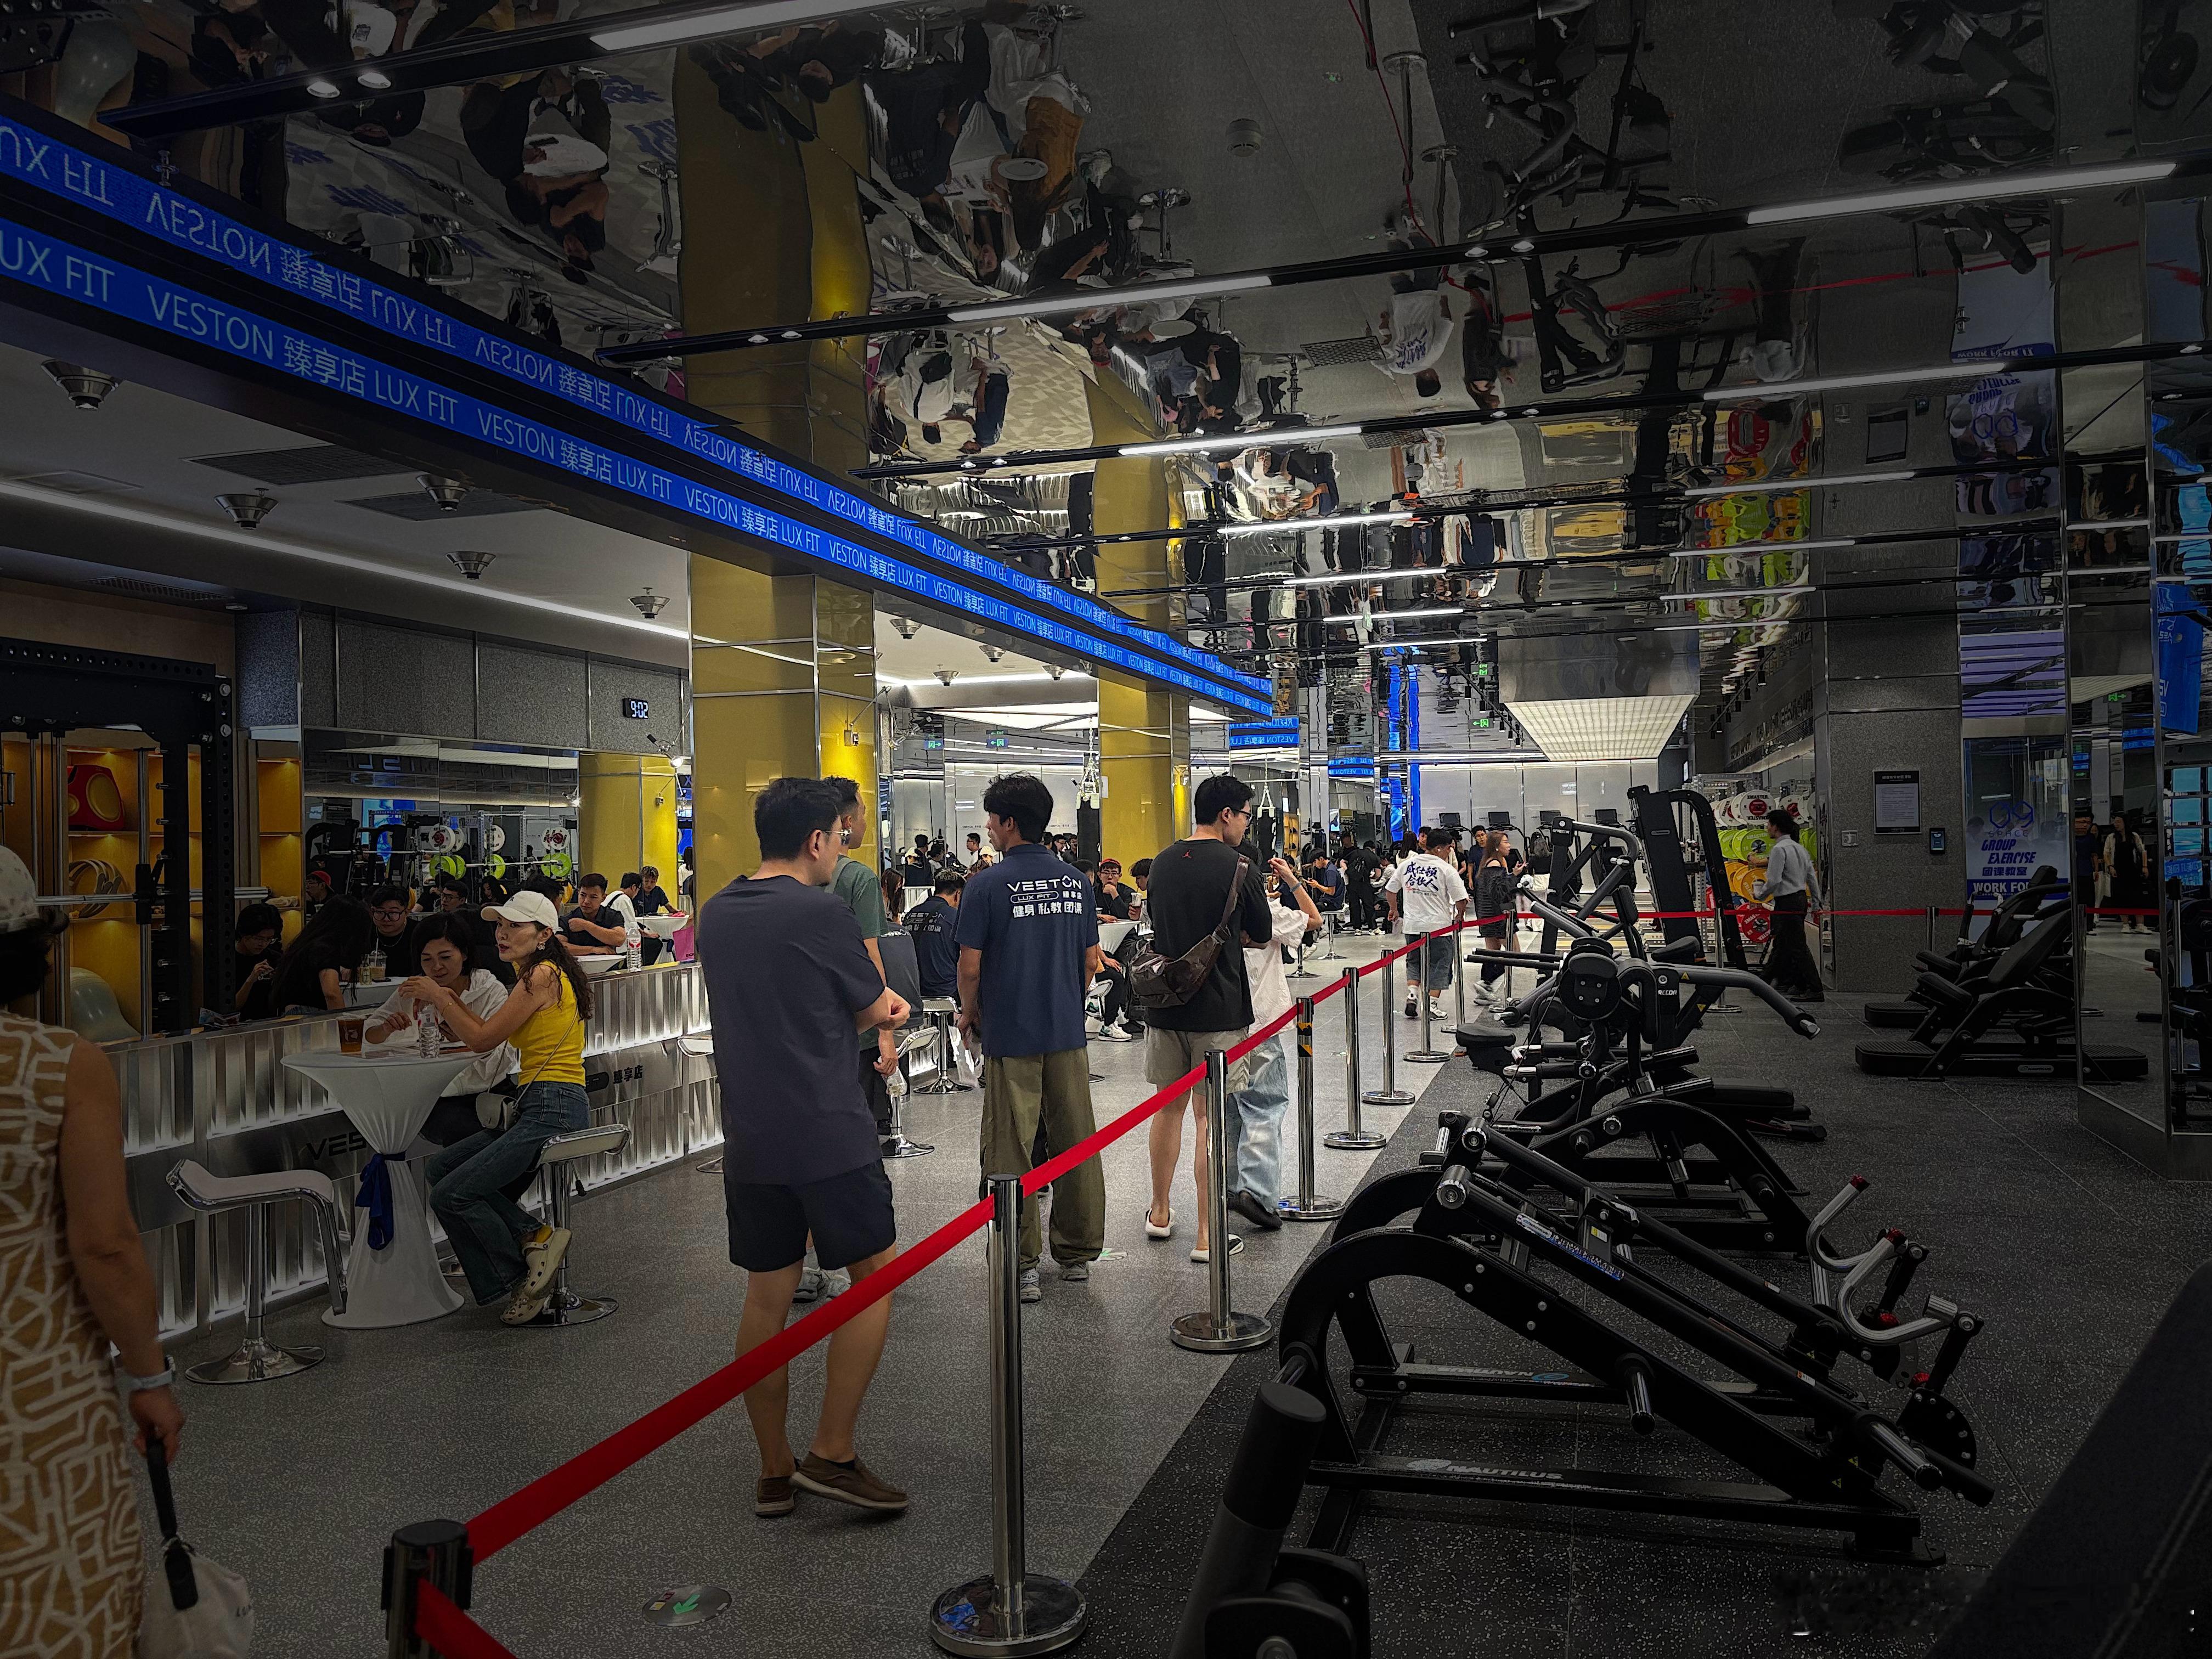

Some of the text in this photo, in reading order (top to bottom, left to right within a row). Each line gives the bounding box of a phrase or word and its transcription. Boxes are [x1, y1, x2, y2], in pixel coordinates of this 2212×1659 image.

[65, 256, 115, 302] FIT
[147, 285, 459, 424] VESTON 臻享店 LUX FIT
[478, 409, 672, 500] VESTON 臻享店 LUX FIT
[685, 486, 820, 553] VESTON 臻享店 LUX FIT
[631, 701, 648, 718] 9:02
[1982, 839, 2016, 851] GROUP
[1988, 851, 2036, 864] EXERCISE
[1403, 861, 1437, 880] 威仕顿
[1982, 867, 2027, 876] 团课教室
[1007, 875, 1082, 892] VESTON
[1404, 874, 1439, 891] 合伙人
[1973, 882, 2007, 893] WORK
[1013, 901, 1082, 918] 健身 私教 团课
[1446, 1465, 1564, 1480] NAUTILUS
